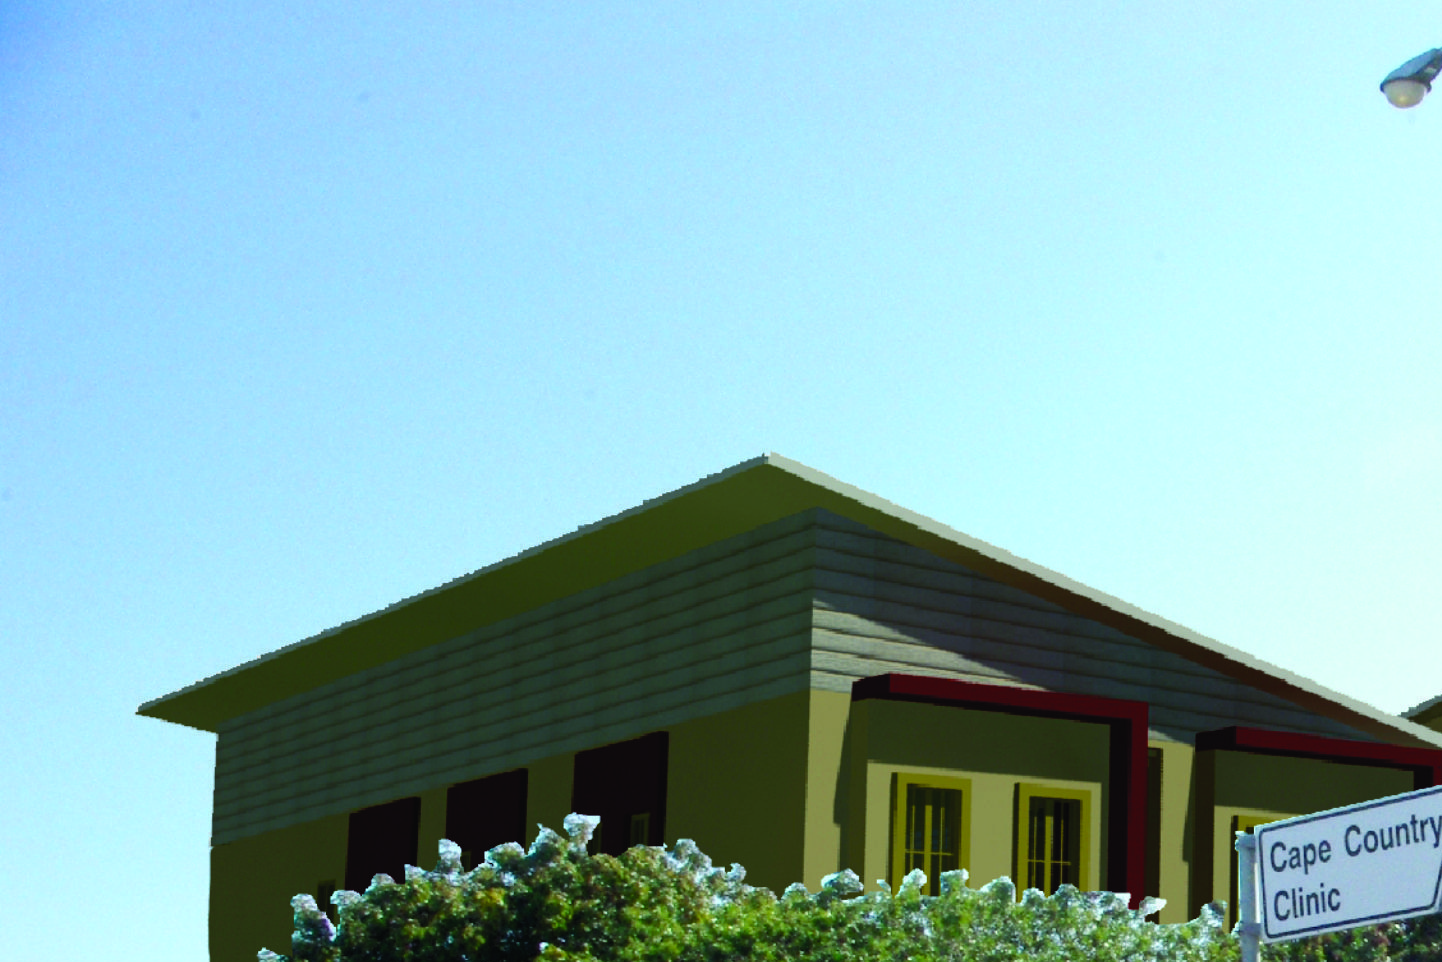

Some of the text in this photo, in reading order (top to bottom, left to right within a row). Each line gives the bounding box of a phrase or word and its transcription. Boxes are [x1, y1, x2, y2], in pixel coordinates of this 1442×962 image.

[1270, 814, 1442, 874] Cape Country
[1273, 883, 1341, 921] Clinic
